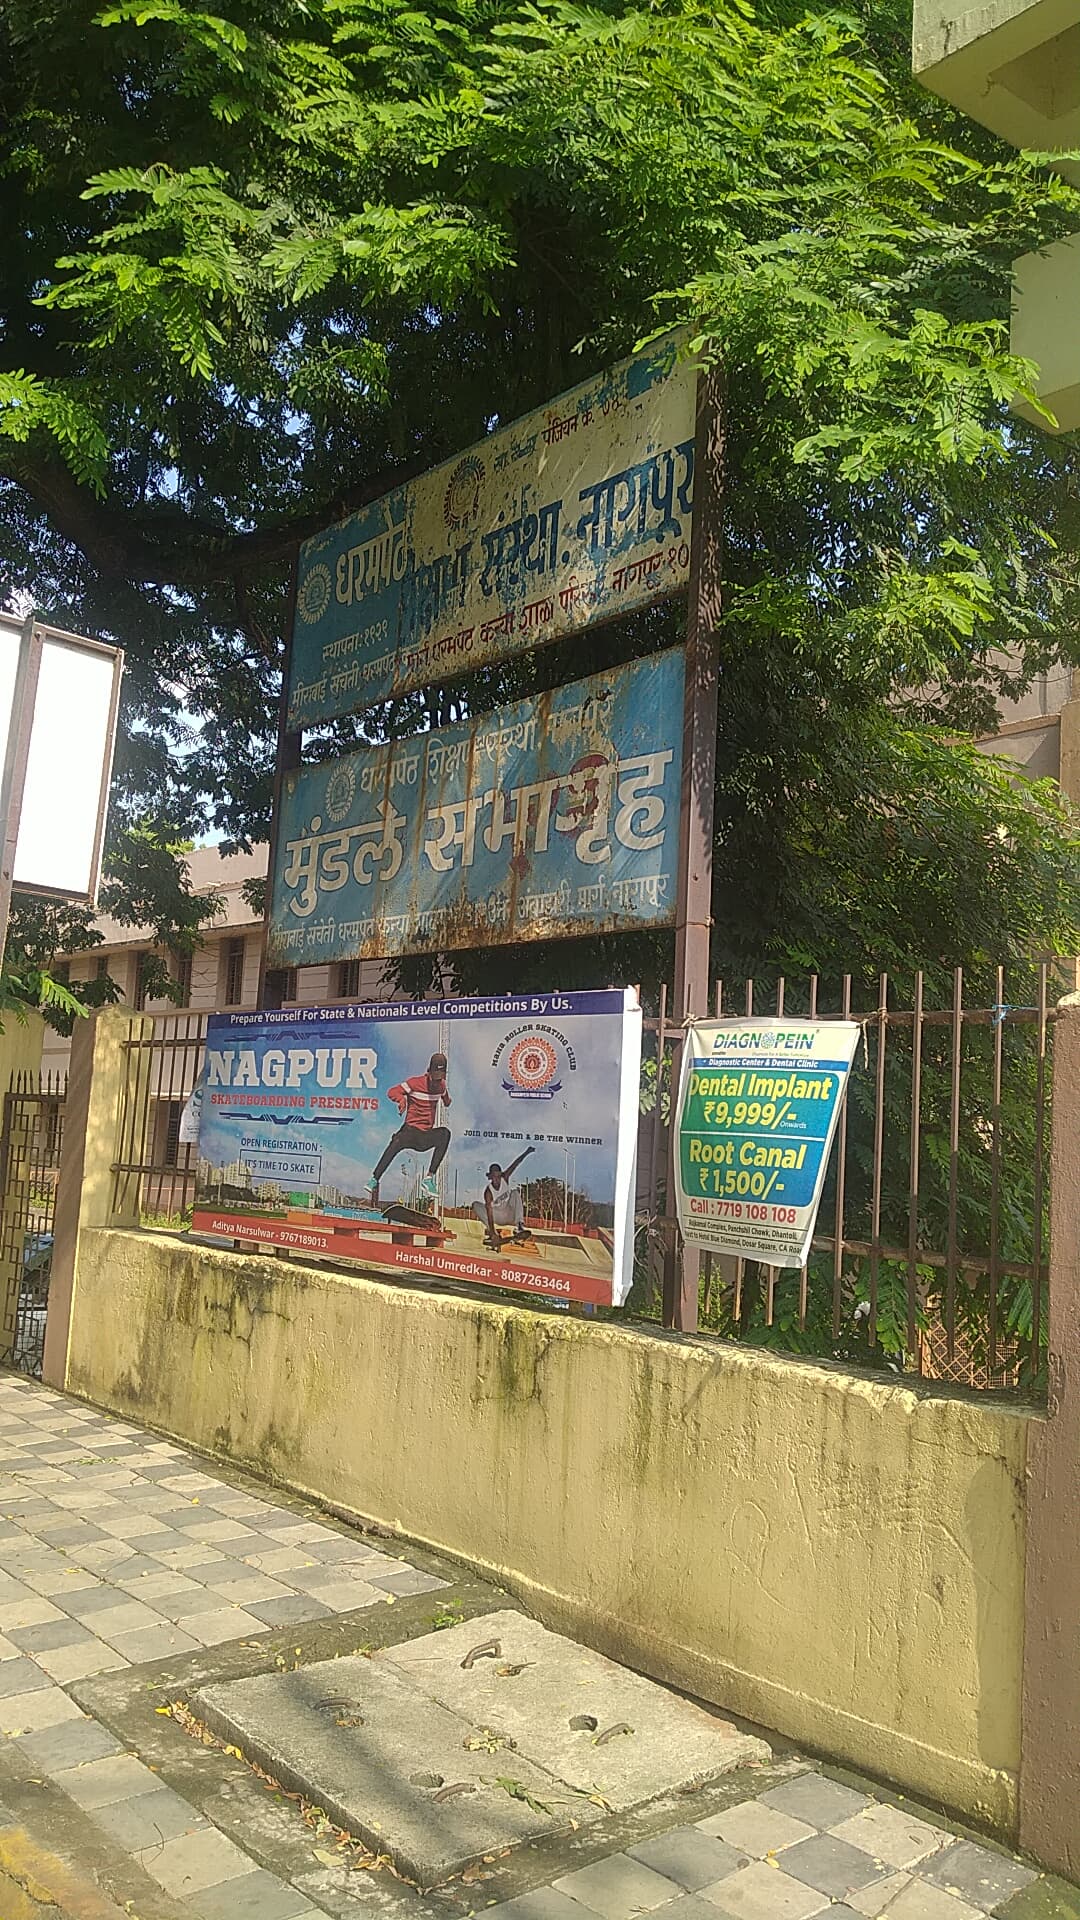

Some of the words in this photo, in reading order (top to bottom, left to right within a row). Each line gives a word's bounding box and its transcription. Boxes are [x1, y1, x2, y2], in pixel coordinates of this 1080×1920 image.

[335, 498, 410, 607] धरमपेठ
[284, 800, 406, 918] मुंडले
[423, 749, 672, 874] सभागृह
[230, 1014, 263, 1026] Prepare
[264, 1011, 301, 1022] Yourself
[302, 1009, 318, 1020] For
[319, 1008, 345, 1019] State
[347, 1007, 355, 1018] &
[357, 1005, 408, 1018] Nationals
[411, 1002, 441, 1016] Level
[443, 999, 529, 1014] Competitions
[531, 998, 549, 1012] By
[551, 997, 573, 1010] Us.
[713, 1032, 815, 1050] DIAGNOPEIN
[207, 1048, 378, 1088] NAGPUR
[708, 1058, 740, 1067] Diagnostic
[741, 1058, 763, 1067] Center
[764, 1059, 770, 1067] &
[771, 1060, 795, 1068] Dental
[796, 1060, 819, 1069] Clinic
[689, 1073, 745, 1097] Dental
[747, 1074, 833, 1101] Implant
[211, 1093, 306, 1108] SKATEBOARDING
[309, 1096, 379, 1111] PRESENTS
[703, 1101, 797, 1129] ₹9,999/-
[780, 1120, 807, 1129] Onwards
[240, 1137, 261, 1147] OPEN
[262, 1139, 318, 1152] REGISTRATION
[689, 1139, 735, 1164] Root
[739, 1141, 808, 1170] Canal
[245, 1159, 257, 1169] IT'S
[259, 1160, 276, 1170] TIME
[278, 1161, 289, 1171] TO
[290, 1163, 315, 1174] SKATE
[713, 1168, 785, 1200] 1,500/-
[690, 1198, 709, 1214] Call
[717, 1201, 742, 1218] 7719
[746, 1205, 768, 1221] 108
[772, 1206, 797, 1224] 108
[212, 1220, 235, 1233] Aditya
[236, 1223, 274, 1239] Narsulwar
[280, 1231, 329, 1249] 9767189013.
[727, 1224, 751, 1235] Panchshil
[751, 1228, 771, 1237] Chowk,
[771, 1231, 798, 1241] Dhantoli,
[741, 1238, 757, 1248] Dosar
[757, 1241, 778, 1252] Square,
[778, 1244, 788, 1253] CA
[395, 1250, 434, 1267] Harshal
[436, 1257, 492, 1278] Umredkar
[501, 1269, 571, 1293] 8087263464
